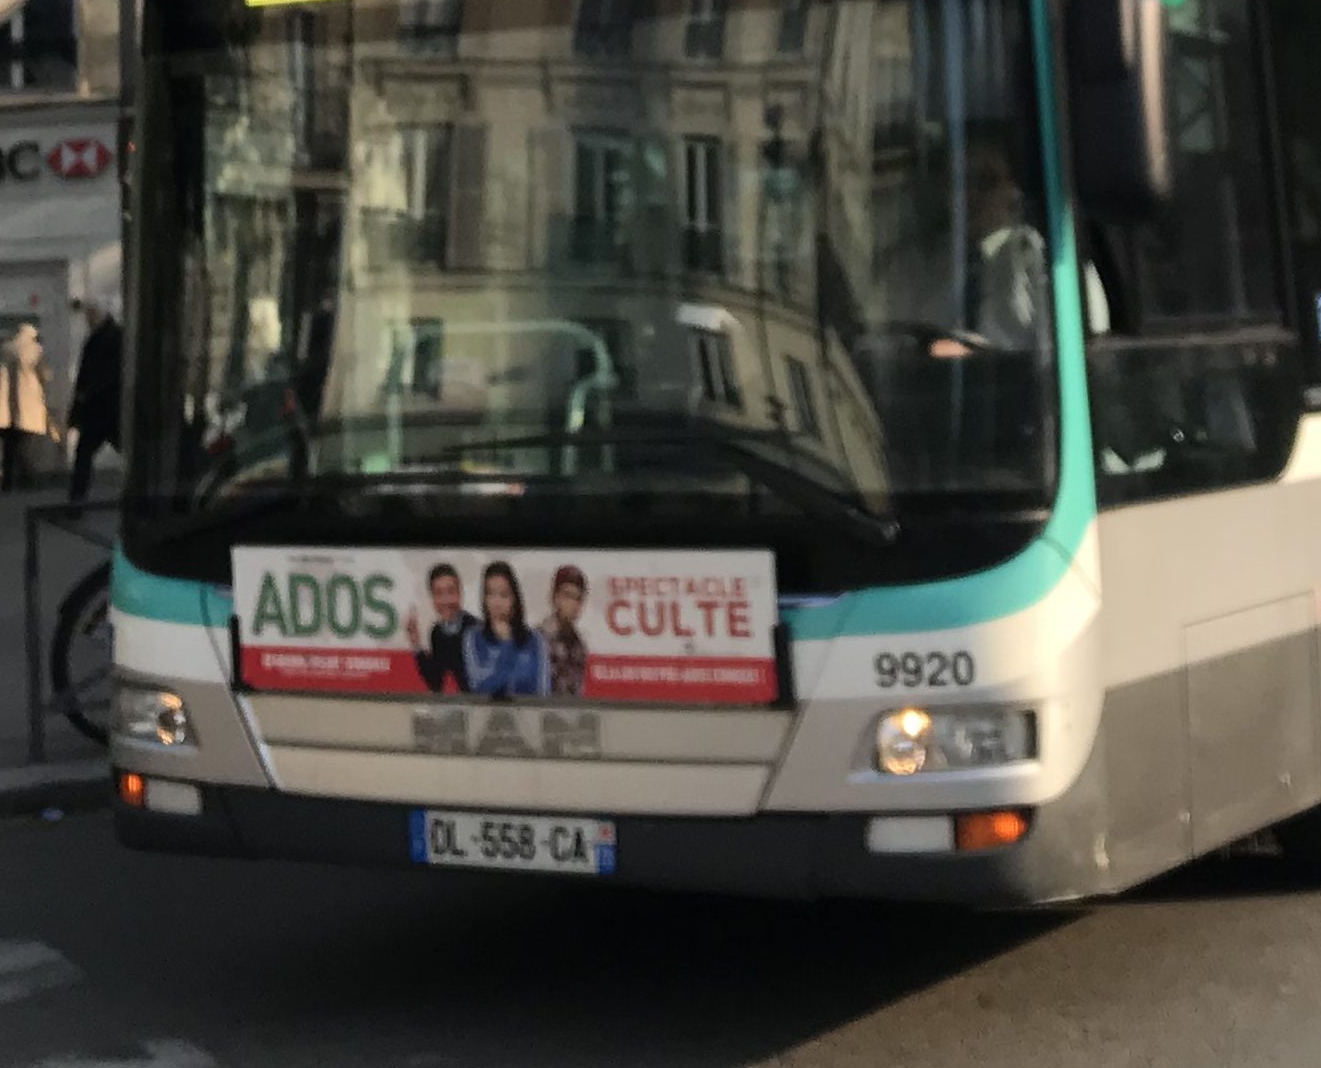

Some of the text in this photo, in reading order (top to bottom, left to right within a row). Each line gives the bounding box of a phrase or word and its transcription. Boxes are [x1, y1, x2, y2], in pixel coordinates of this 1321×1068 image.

[251, 570, 399, 639] ADOS
[607, 575, 746, 597] SPECTACLE
[605, 599, 753, 638] CULTE
[874, 650, 976, 688] 9920
